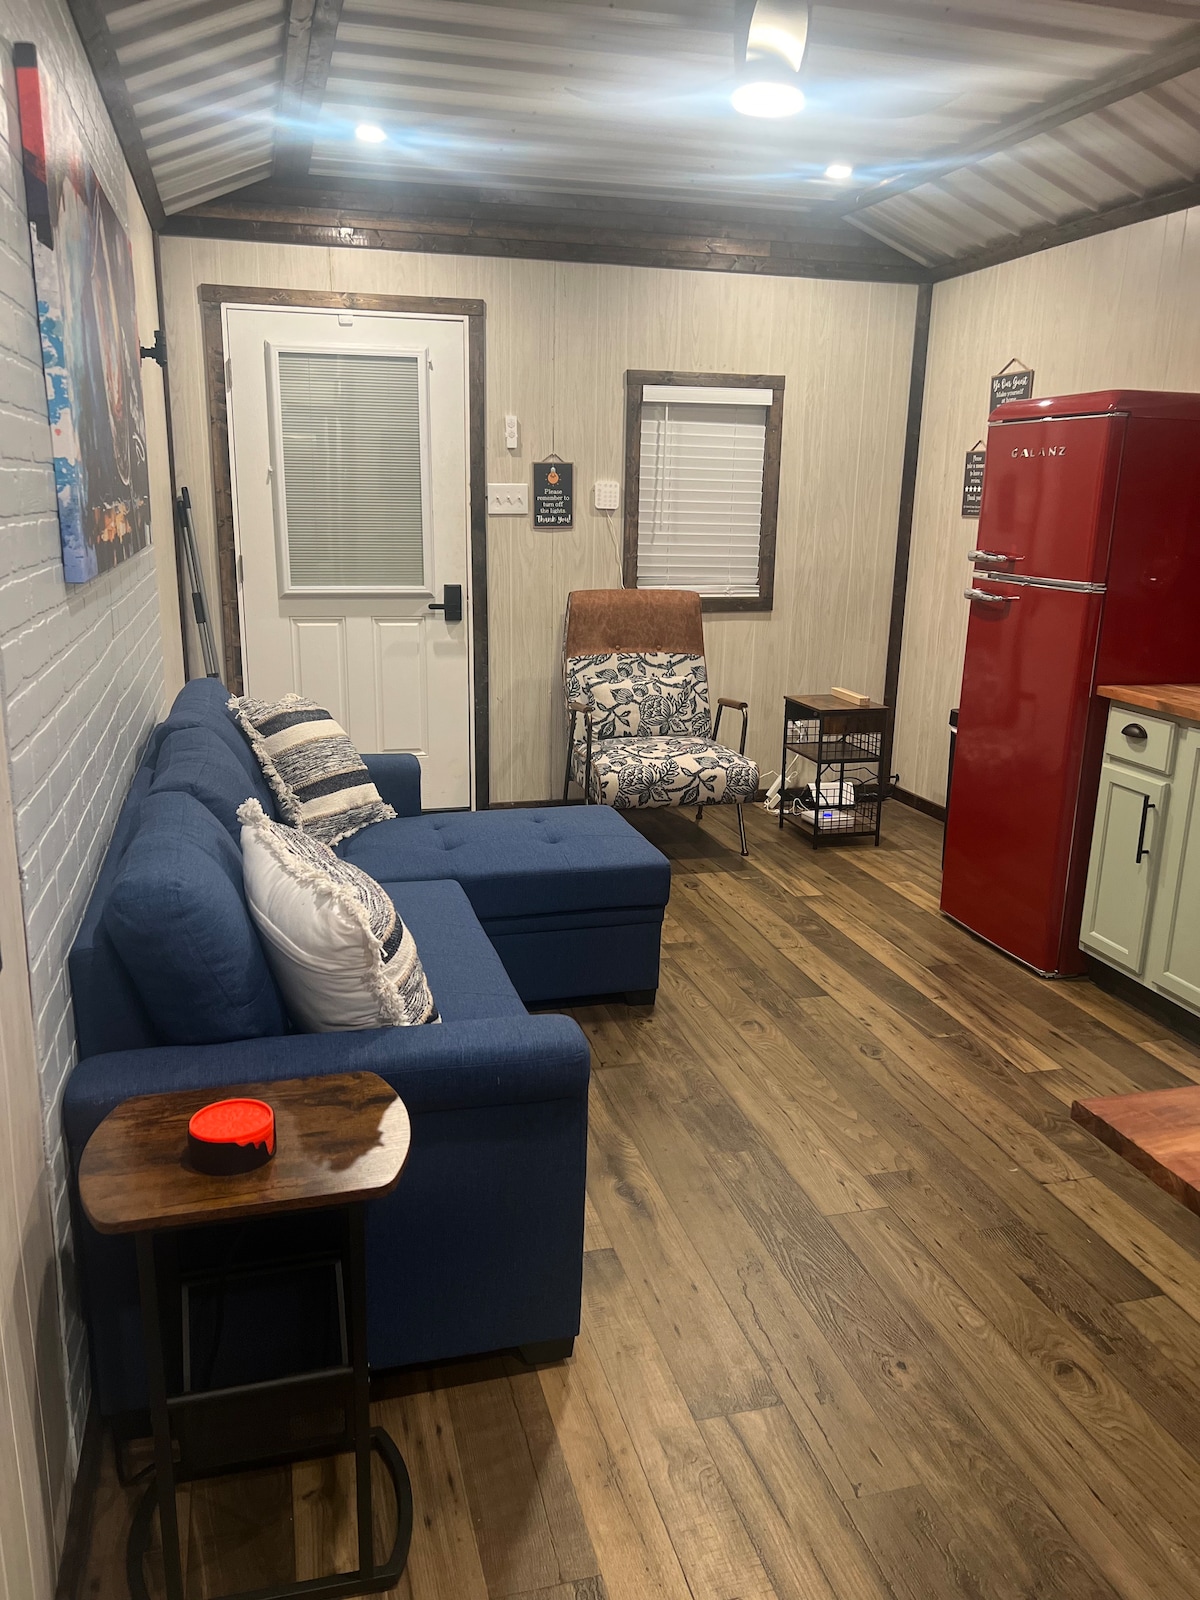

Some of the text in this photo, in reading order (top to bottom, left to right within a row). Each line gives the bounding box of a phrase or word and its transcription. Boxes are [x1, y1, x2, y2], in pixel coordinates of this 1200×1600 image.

[1012, 376, 1028, 389] Guest
[1011, 446, 1066, 458] GALANZ
[536, 514, 571, 524] Thank you!
